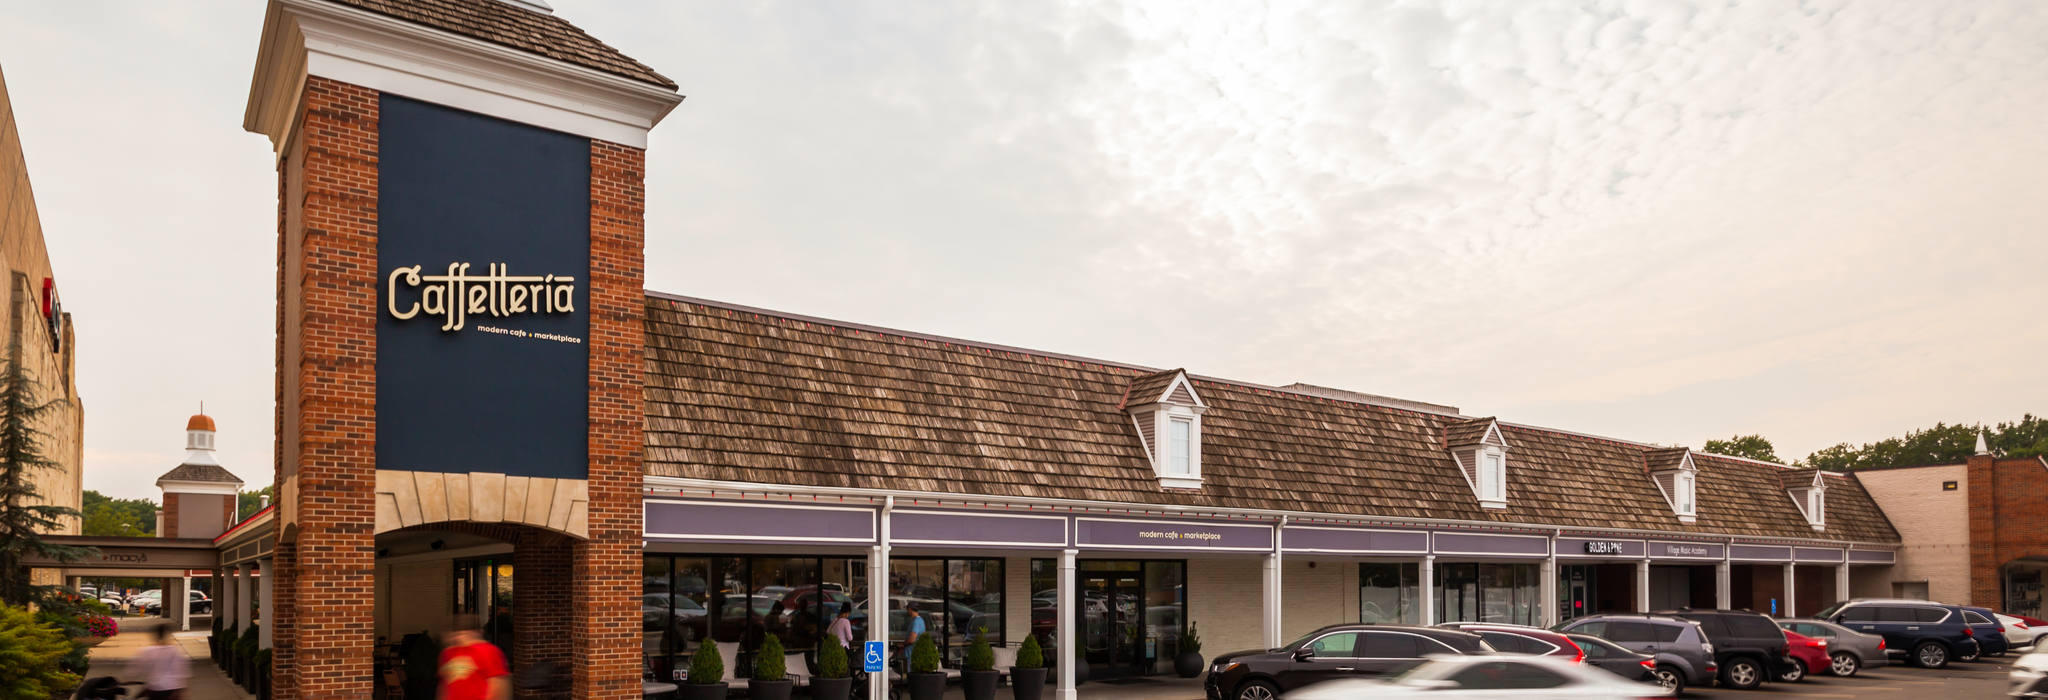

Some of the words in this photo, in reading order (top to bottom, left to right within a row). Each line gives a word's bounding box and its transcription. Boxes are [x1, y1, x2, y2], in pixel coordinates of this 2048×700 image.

[477, 325, 508, 335] modern
[509, 329, 527, 338] cafe
[534, 332, 582, 344] marketplace
[1139, 530, 1164, 538] modern
[1164, 530, 1179, 540] cafe
[1183, 531, 1221, 541] marketplace
[1589, 541, 1607, 554] GOLDEN
[1666, 545, 1680, 557] Village
